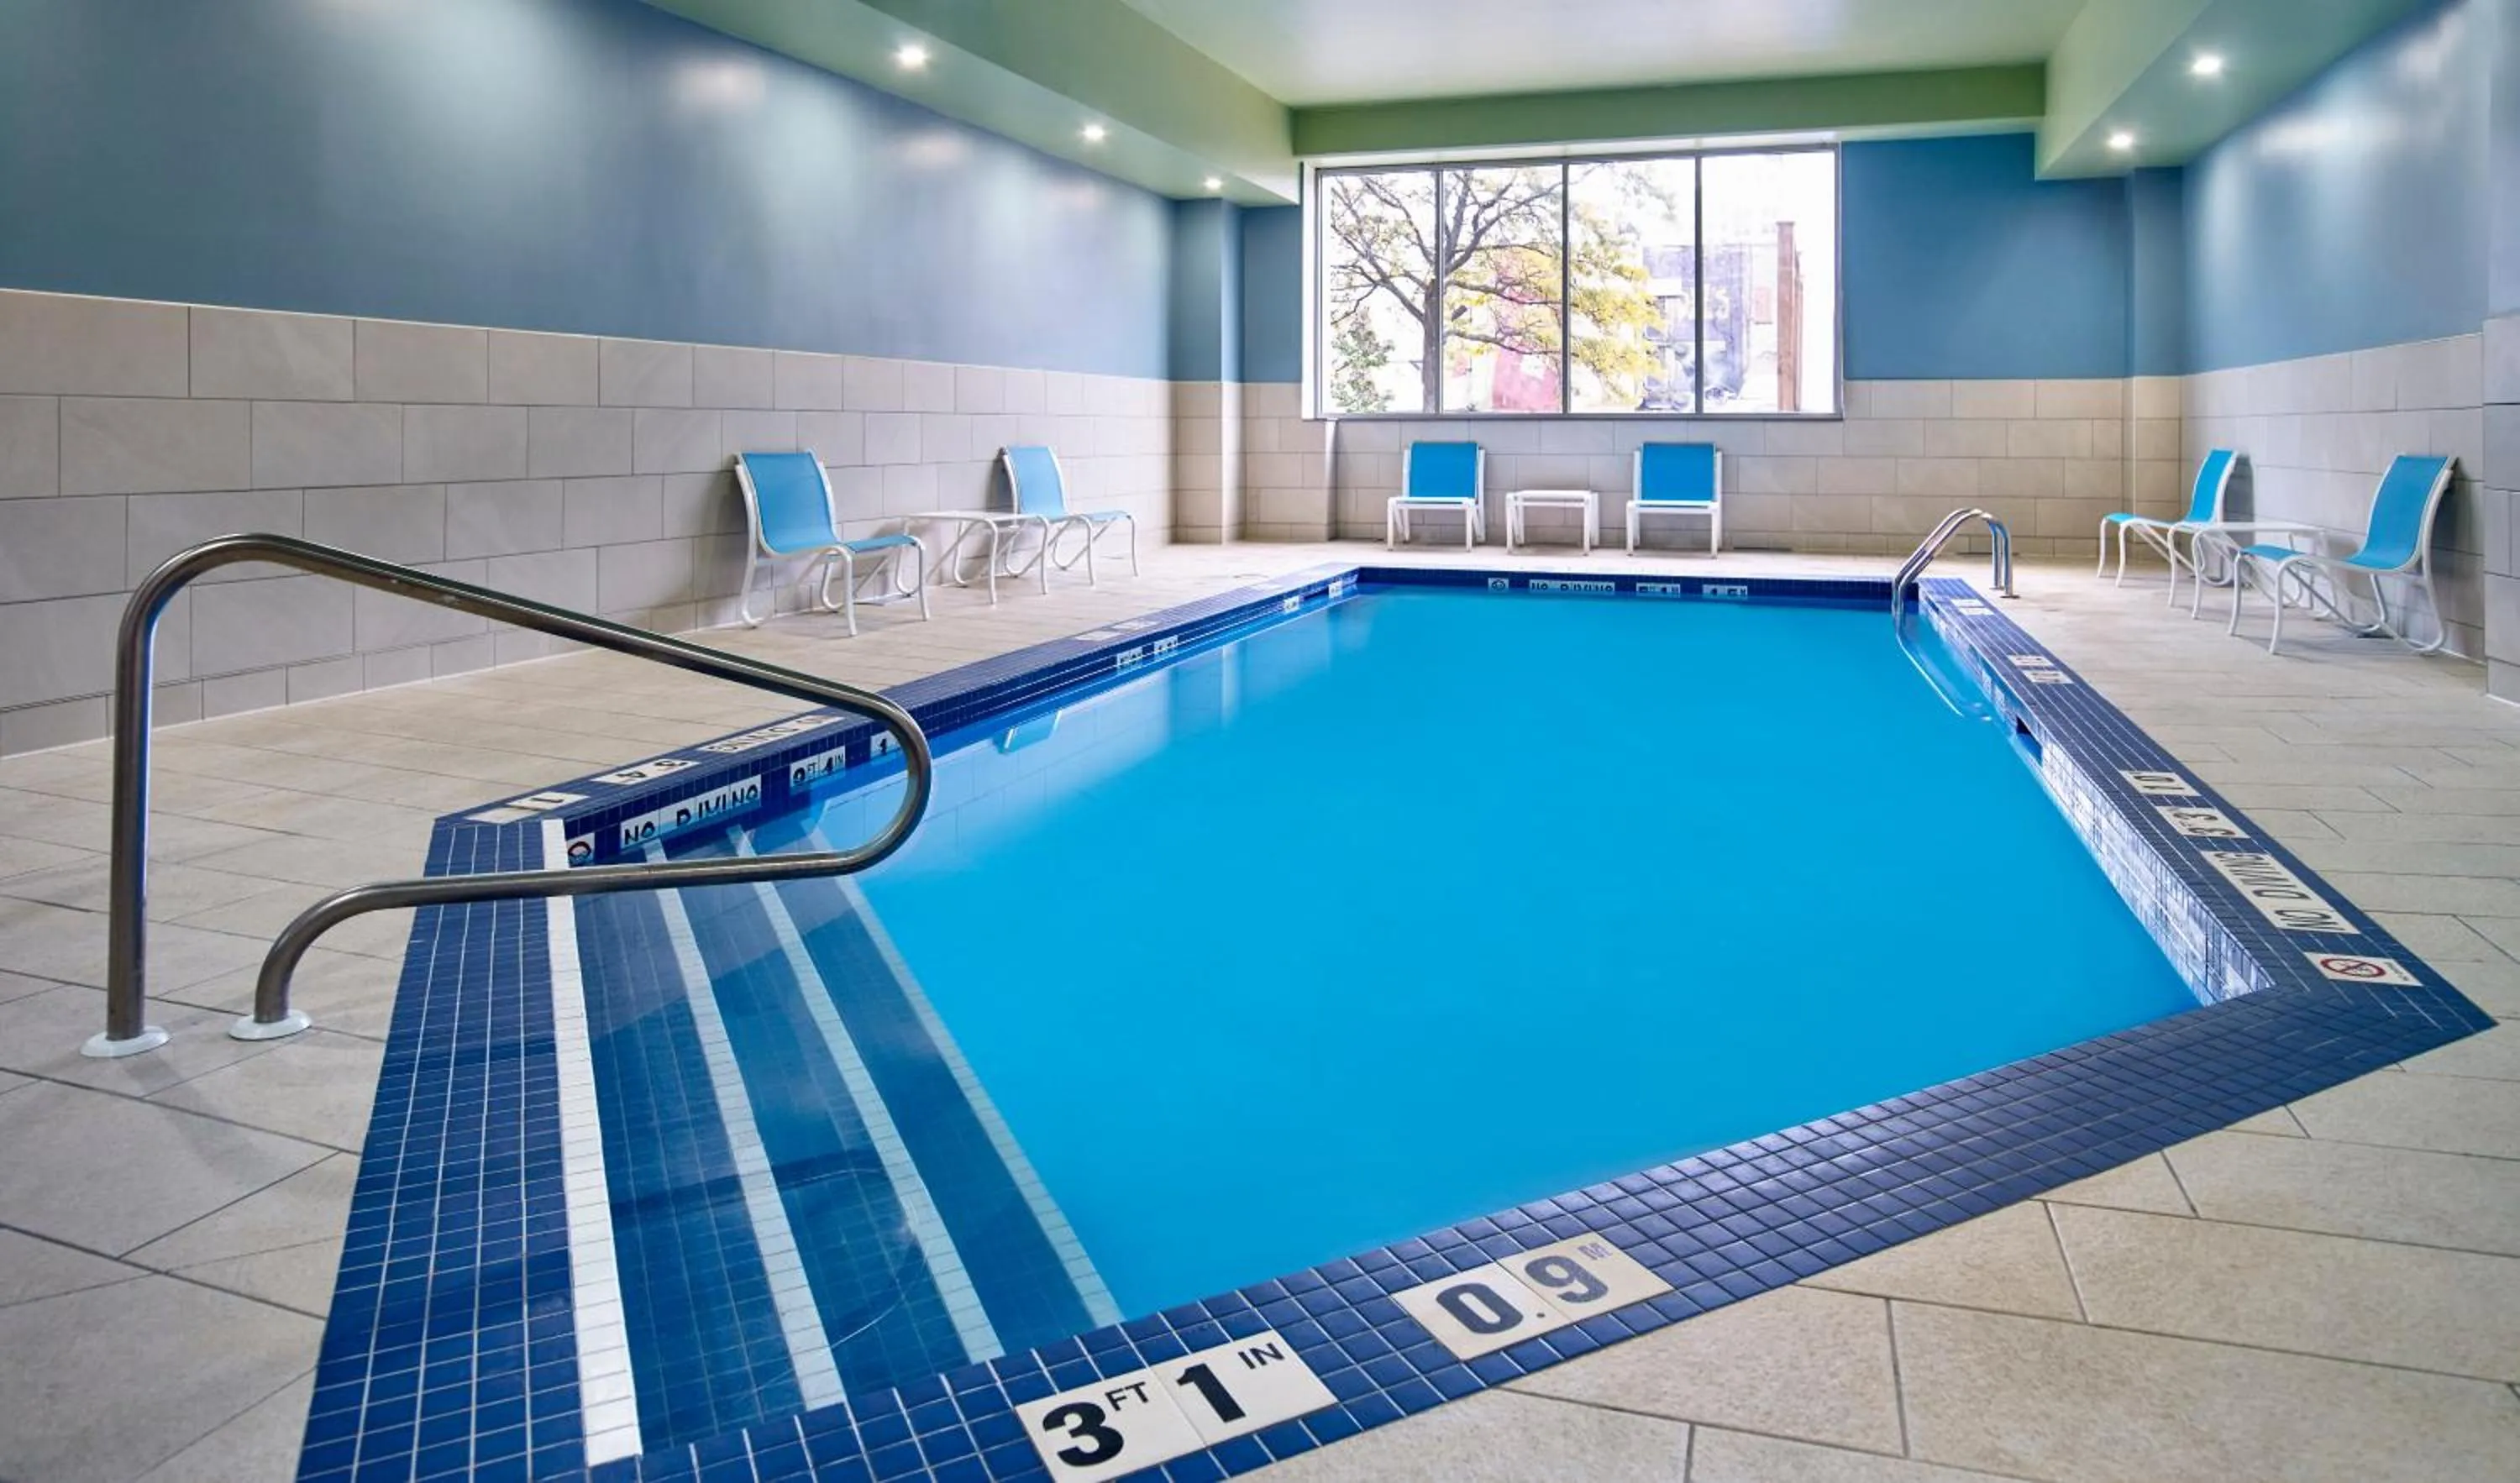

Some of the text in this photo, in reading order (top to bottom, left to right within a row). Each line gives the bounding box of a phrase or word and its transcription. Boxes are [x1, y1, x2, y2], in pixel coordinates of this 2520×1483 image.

[624, 820, 655, 846] NO
[2213, 852, 2346, 931] NO DIVING
[1042, 1342, 1286, 1468] 3 FT 1 IN
